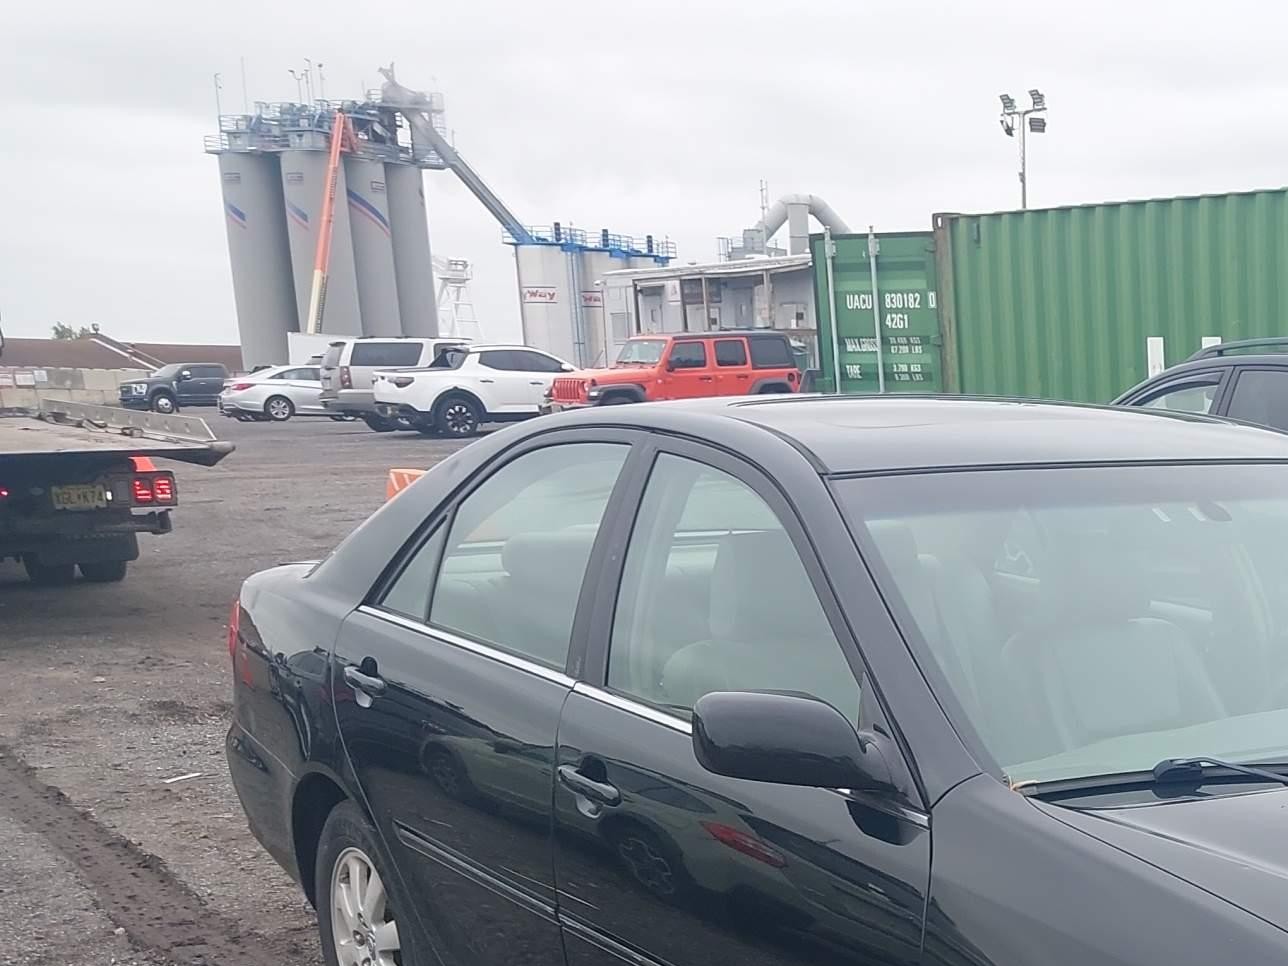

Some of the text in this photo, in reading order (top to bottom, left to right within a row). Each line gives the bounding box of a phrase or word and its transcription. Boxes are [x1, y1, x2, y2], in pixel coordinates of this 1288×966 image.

[846, 294, 872, 309] UACU
[885, 292, 921, 309] 830182
[885, 313, 909, 329] 42G1
